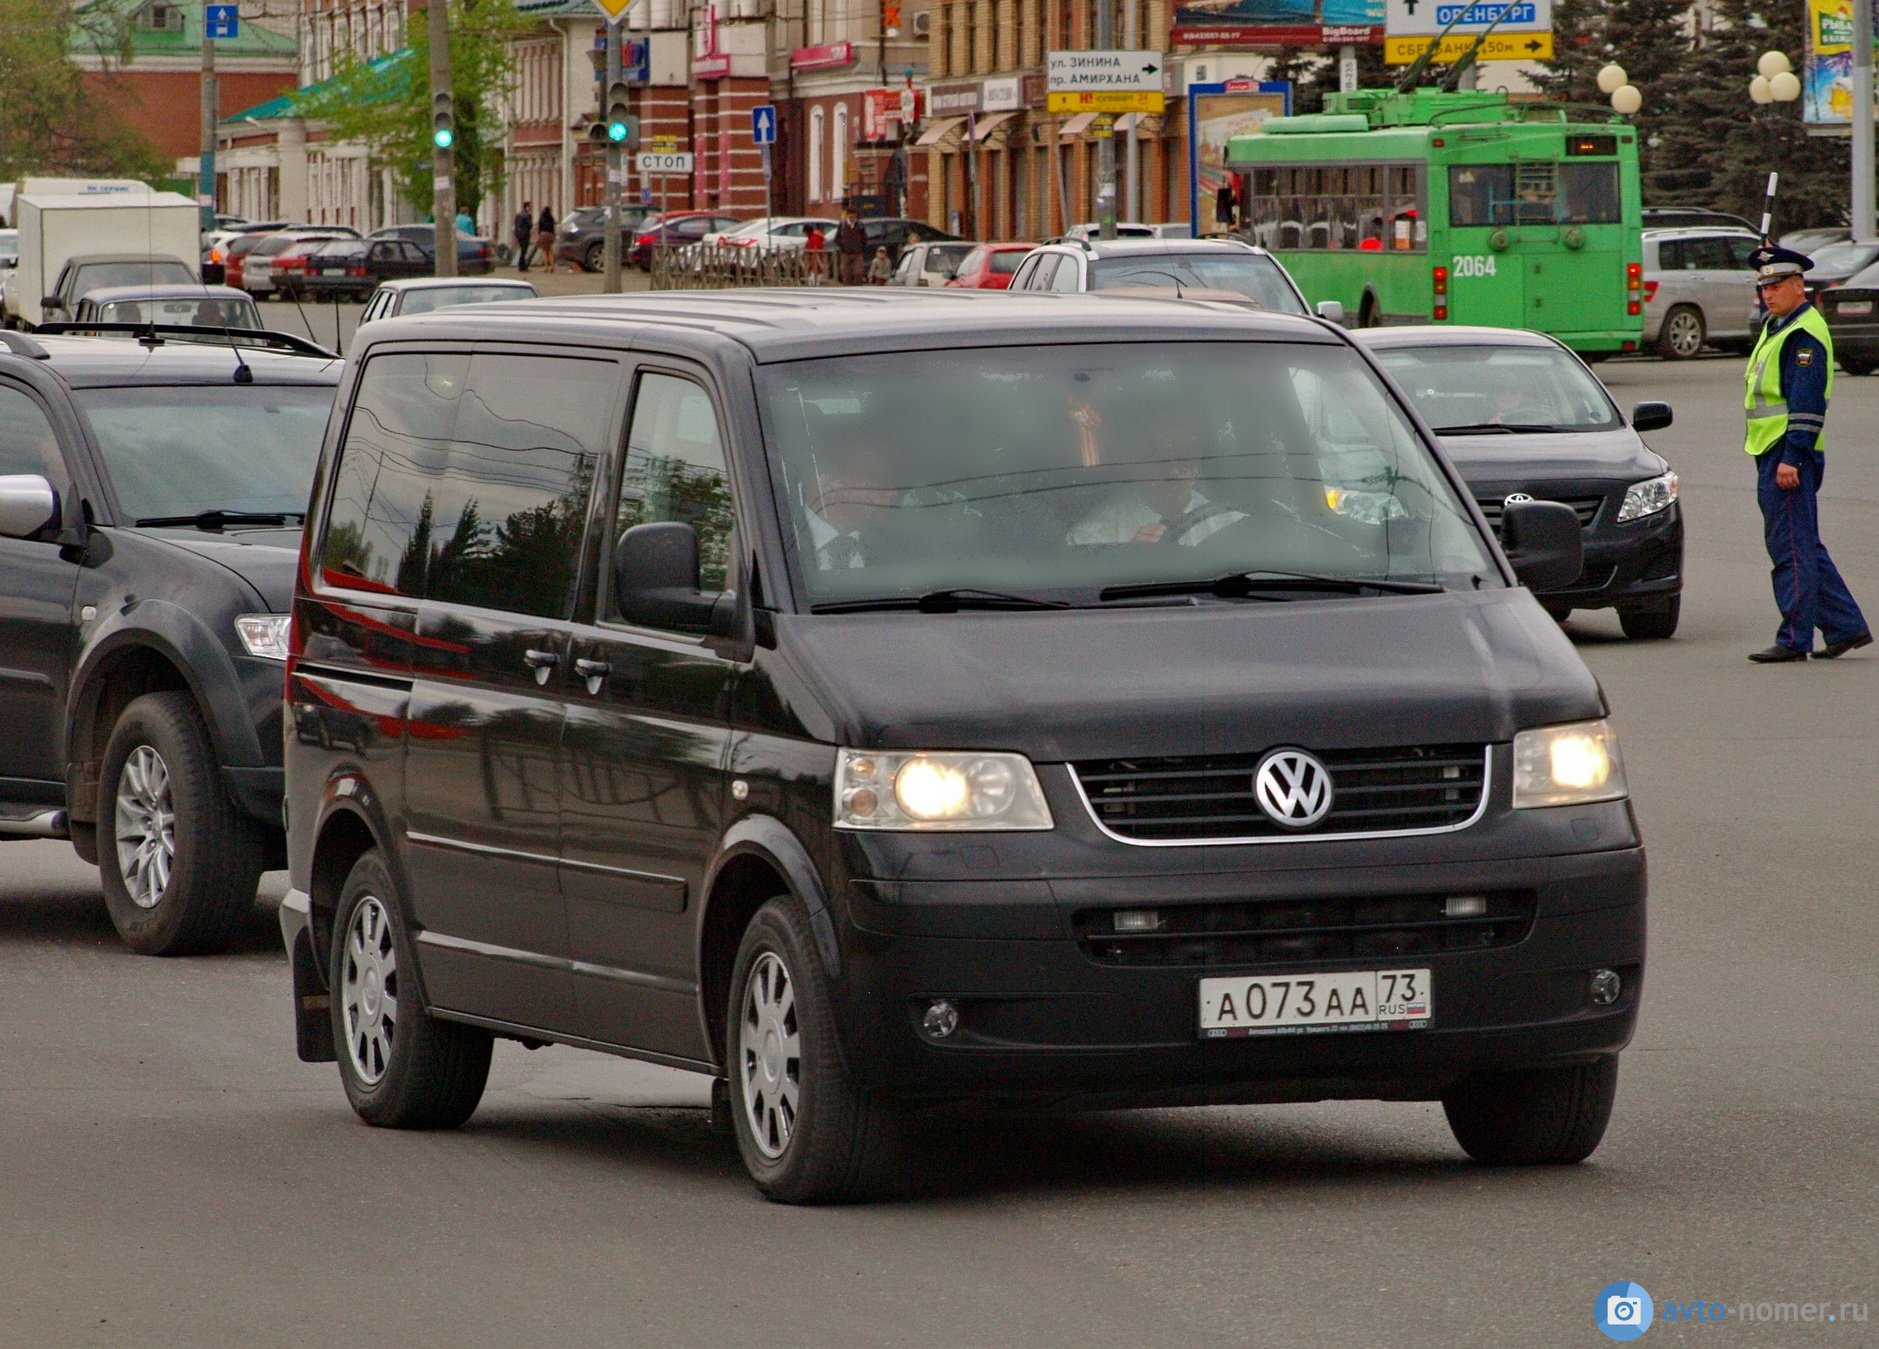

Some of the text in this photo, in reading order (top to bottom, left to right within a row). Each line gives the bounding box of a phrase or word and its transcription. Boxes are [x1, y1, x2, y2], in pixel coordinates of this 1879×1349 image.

[1439, 6, 1533, 23] ОРЕНБУРГ
[1322, 27, 1370, 37] BigBoard
[1050, 57, 1121, 70] ул. ЗИНИНА
[1050, 74, 1141, 86] пр. АМИРХАНА
[642, 155, 685, 168] СТОП
[1453, 255, 1497, 277] 2064
[1381, 973, 1417, 1003] 73
[1379, 1004, 1406, 1015] RUS
